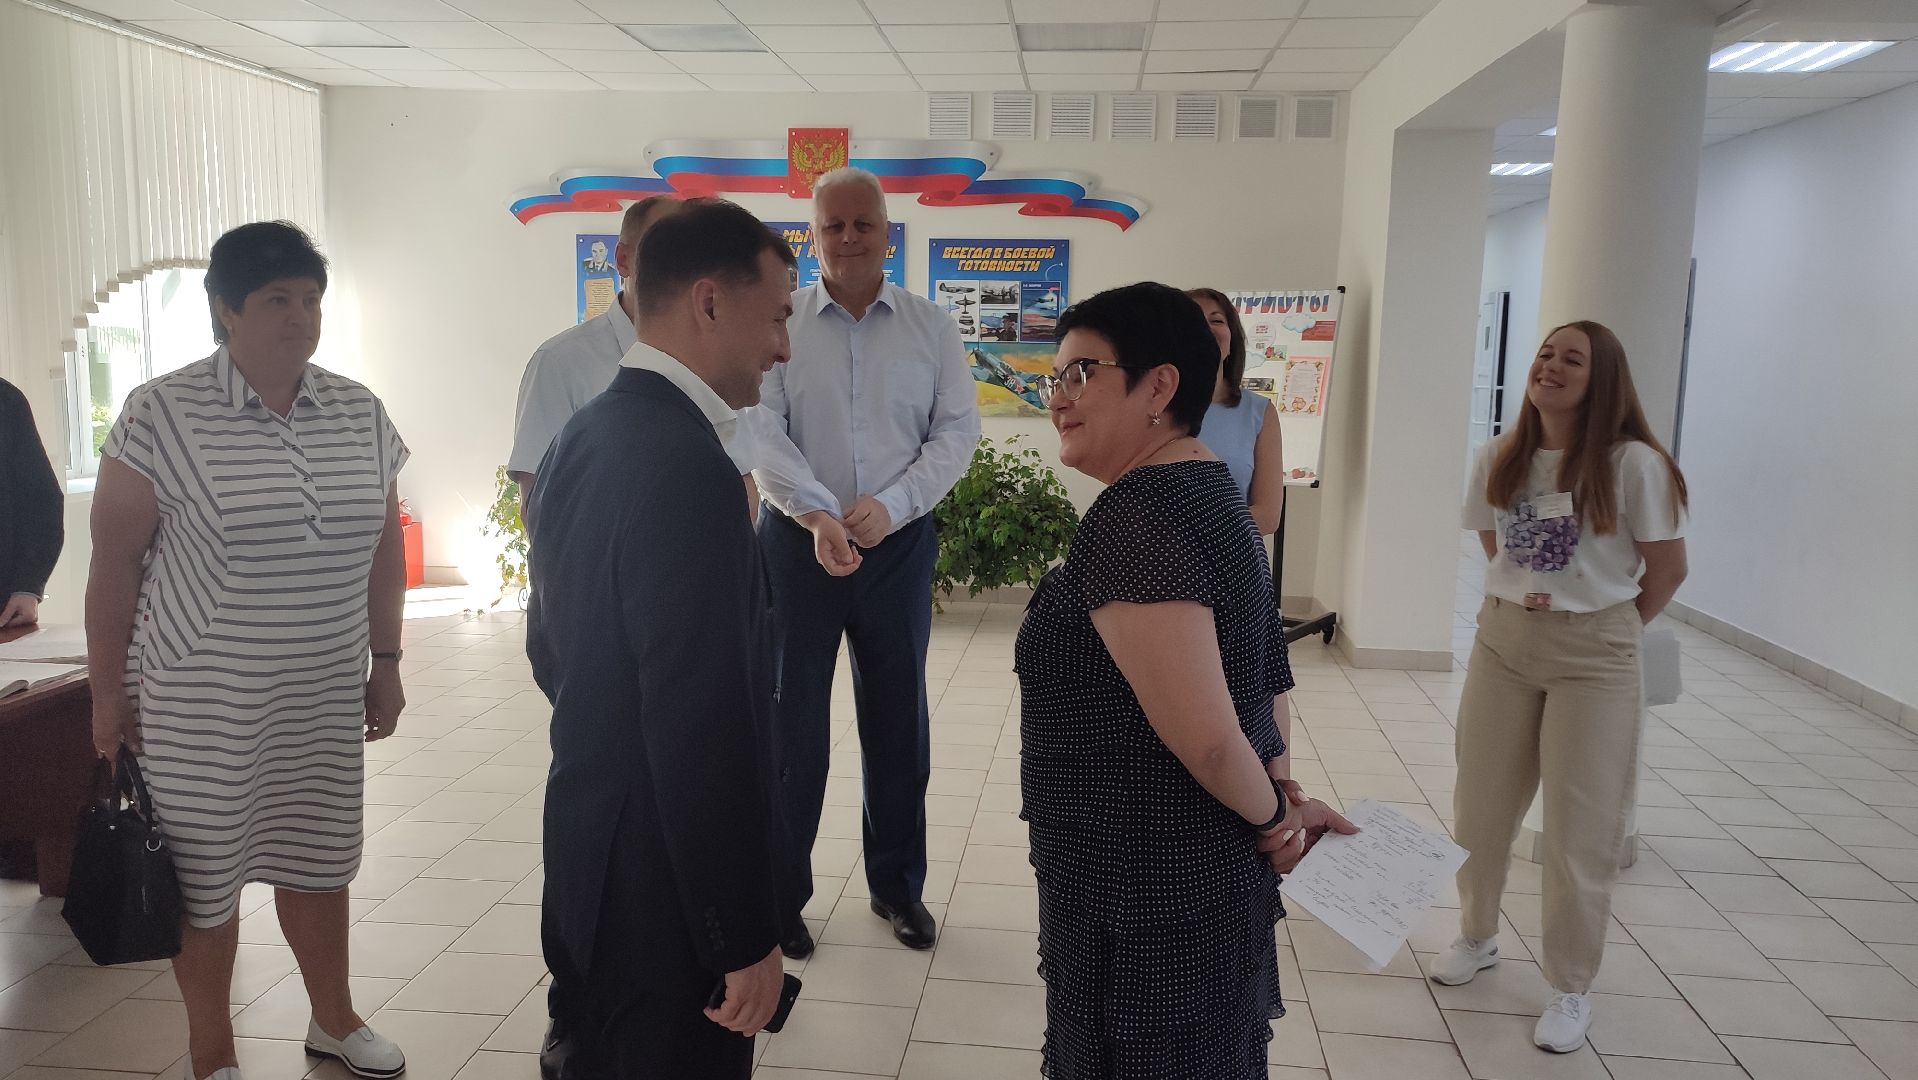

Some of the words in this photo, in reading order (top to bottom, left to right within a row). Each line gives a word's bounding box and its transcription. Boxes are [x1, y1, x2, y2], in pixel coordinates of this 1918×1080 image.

[942, 246, 990, 259] ВСЕГДА
[992, 247, 1004, 259] В
[1004, 245, 1056, 259] БОЕВОЙ
[957, 260, 1041, 272] ГОТОВНОСТИ
[1231, 294, 1330, 314] ТРИОТЫ
